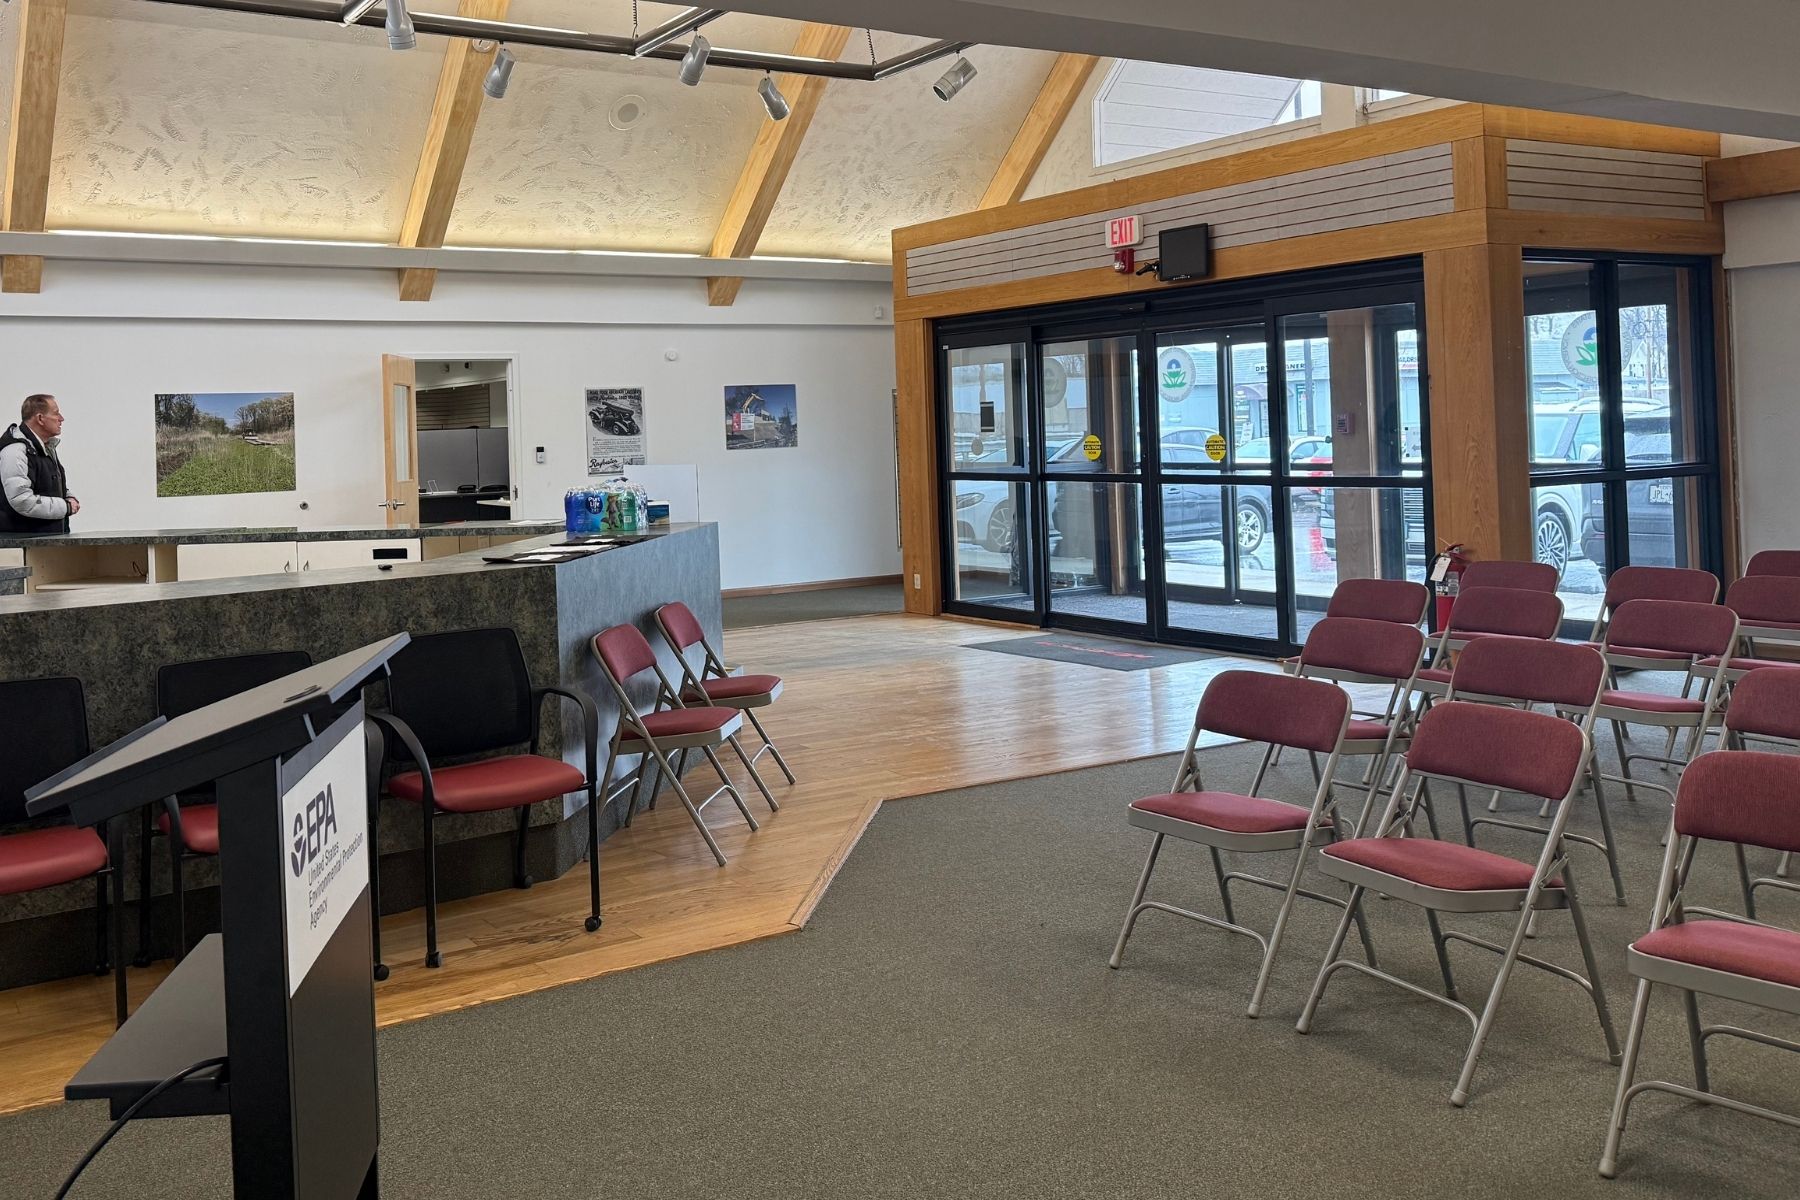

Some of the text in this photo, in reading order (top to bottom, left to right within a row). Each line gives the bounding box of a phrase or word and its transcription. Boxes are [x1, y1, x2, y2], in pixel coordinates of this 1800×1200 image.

[1110, 217, 1134, 245] EXIT
[589, 501, 600, 509] Life
[306, 782, 338, 864] EPA
[308, 841, 340, 887] United States
[308, 832, 364, 908] Environmental Protection
[310, 897, 329, 931] Agency
